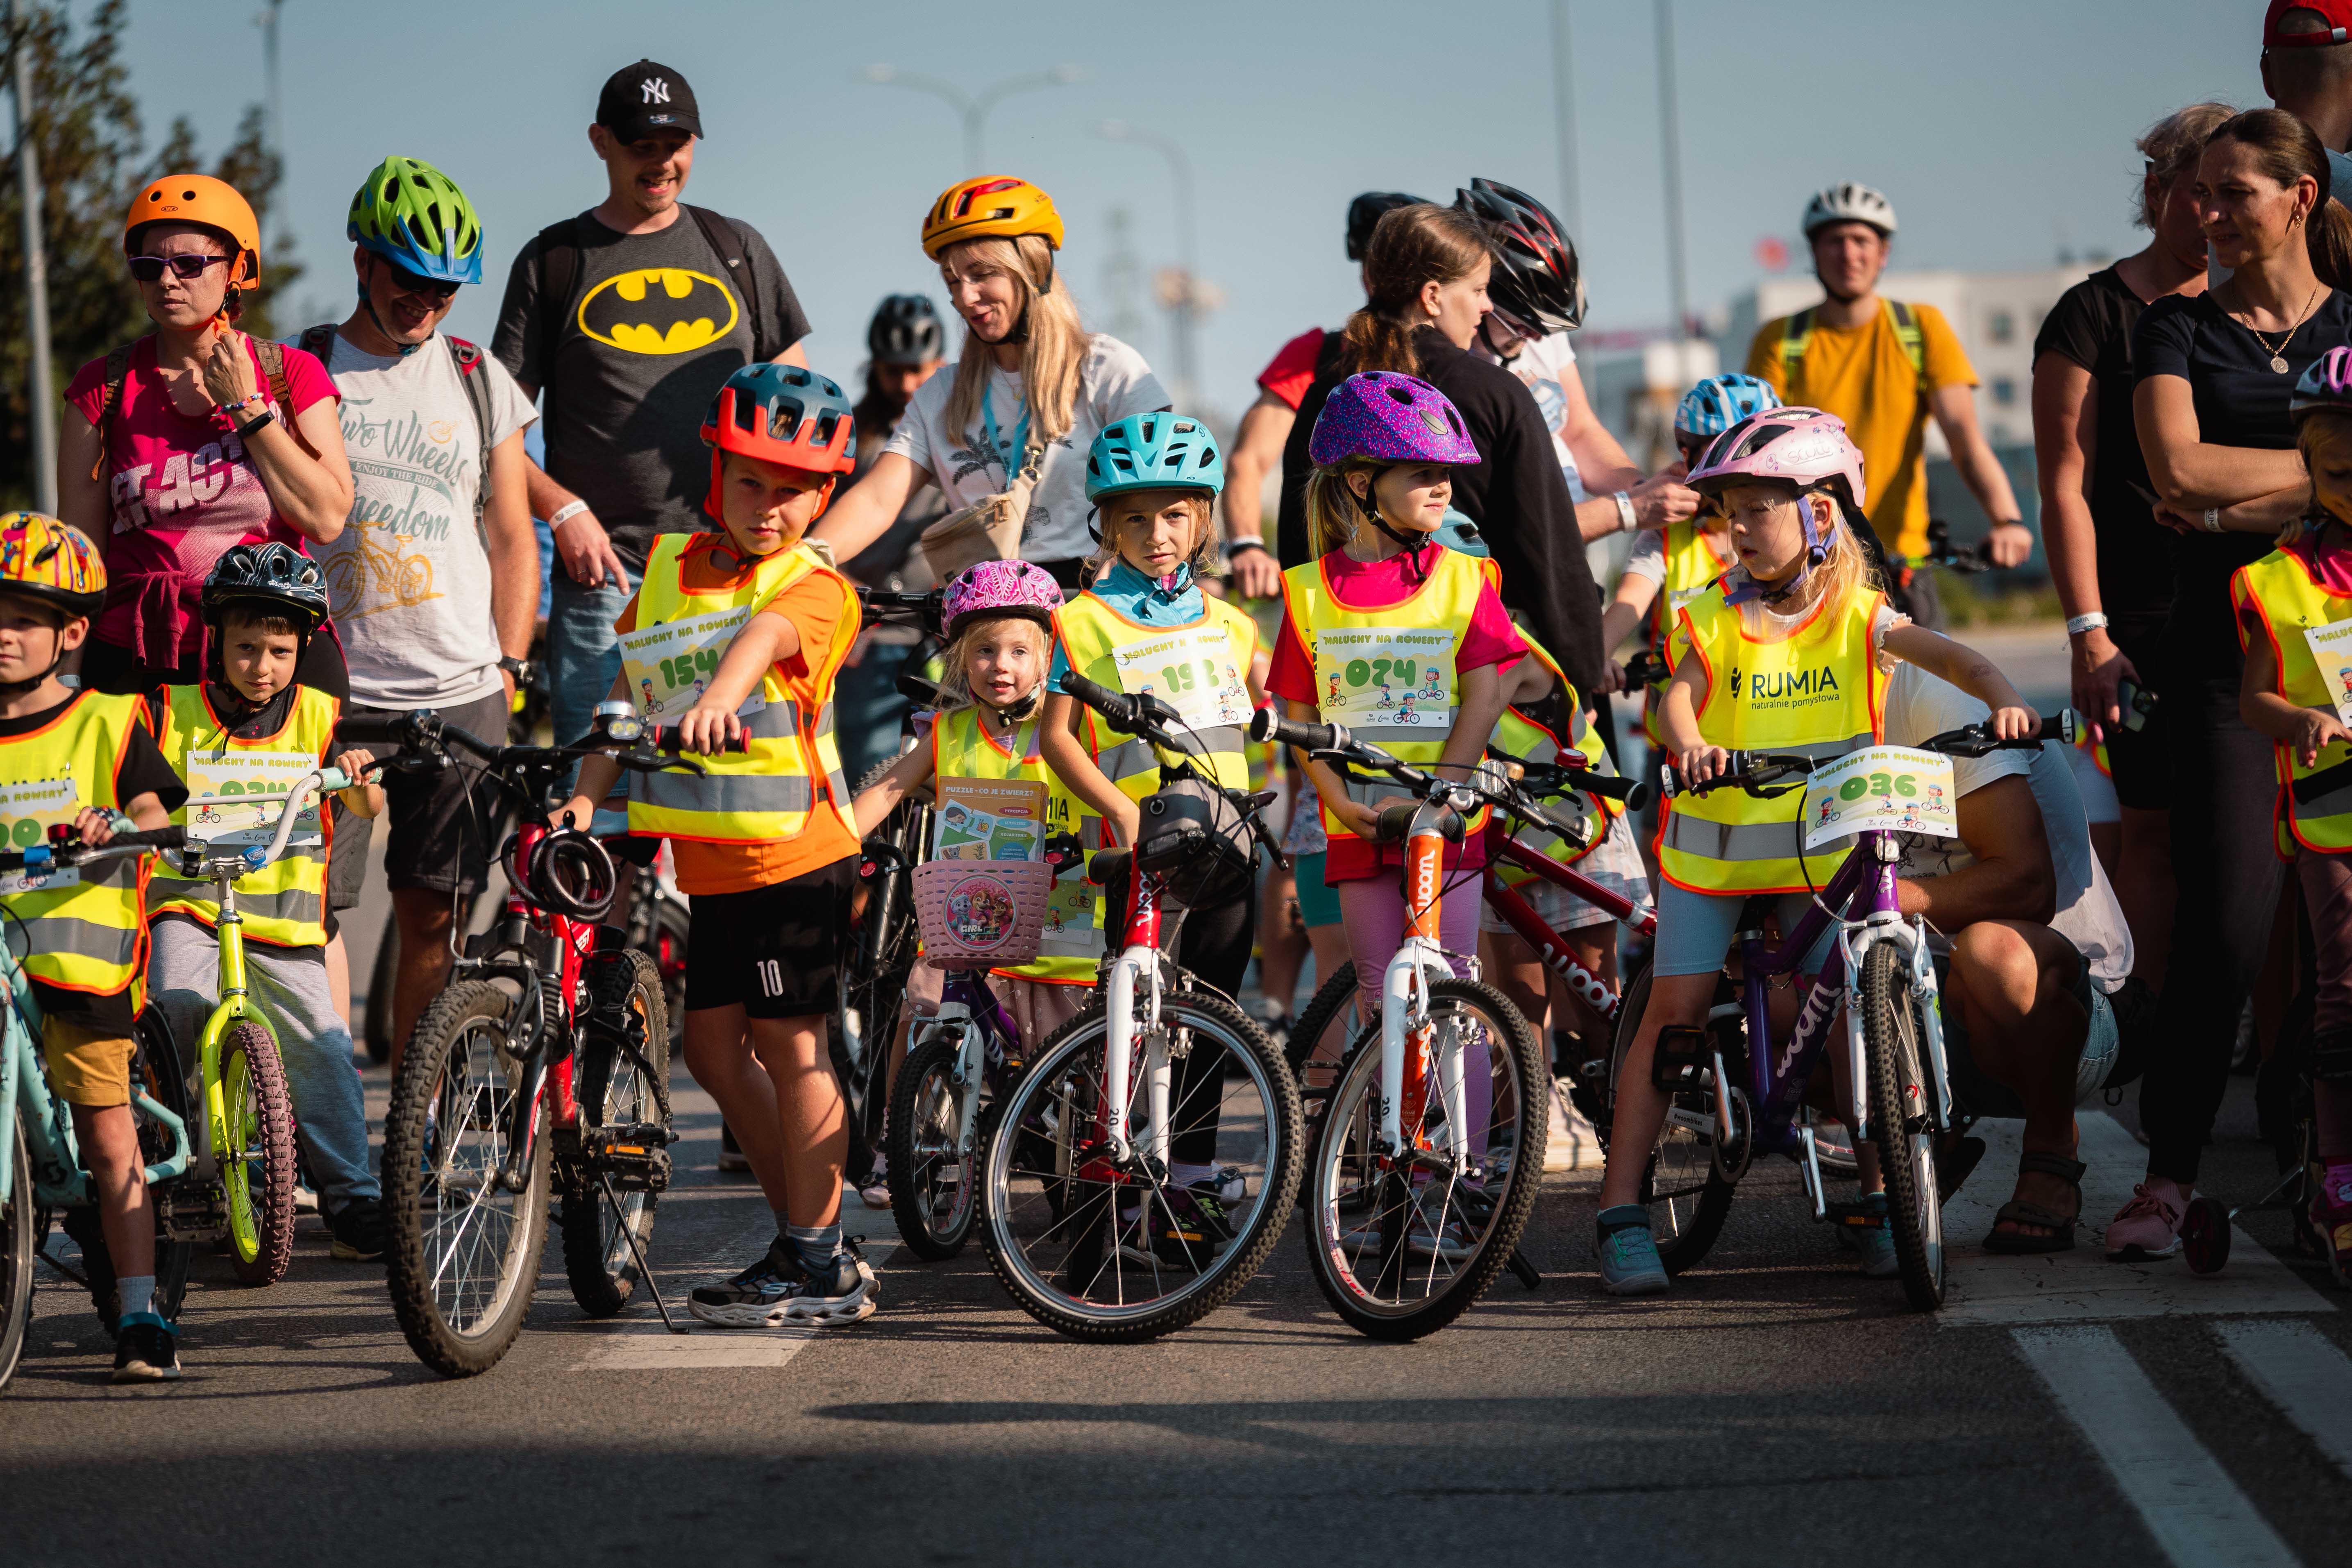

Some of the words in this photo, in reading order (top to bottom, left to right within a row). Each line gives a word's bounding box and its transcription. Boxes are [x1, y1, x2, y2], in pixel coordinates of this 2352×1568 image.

[384, 410, 468, 486] Wheels
[356, 463, 388, 476] ENJOY
[392, 470, 413, 481] THE
[415, 474, 440, 488] RIDE
[111, 463, 152, 534] ET
[627, 631, 673, 651] MALUCHY
[678, 626, 693, 638] NA
[698, 615, 744, 633] ROWERY
[1325, 635, 1371, 645] MALUCHY
[1376, 635, 1391, 644] NA
[1396, 635, 1442, 645] ROWERY
[660, 649, 718, 689] 154
[1345, 659, 1417, 687] 074
[1752, 666, 1839, 699] RUMIA
[1751, 698, 1790, 710] naturalnie
[1792, 693, 1839, 710] pomysłowa
[196, 758, 245, 767] MALUCHY
[250, 758, 263, 767] NA
[268, 759, 309, 769] ROWERY
[1816, 754, 1866, 781] MALUCHY
[1893, 753, 1942, 766] ROWERY
[0, 794, 8, 805] A
[14, 789, 64, 802] ROWERY
[1000, 789, 1034, 797] ZWIERZ?
[1840, 773, 1916, 801] 036
[1416, 849, 1436, 917] woom
[757, 960, 783, 997] 10
[1109, 1108, 1119, 1126] 20
[1383, 1097, 1390, 1116] 20
